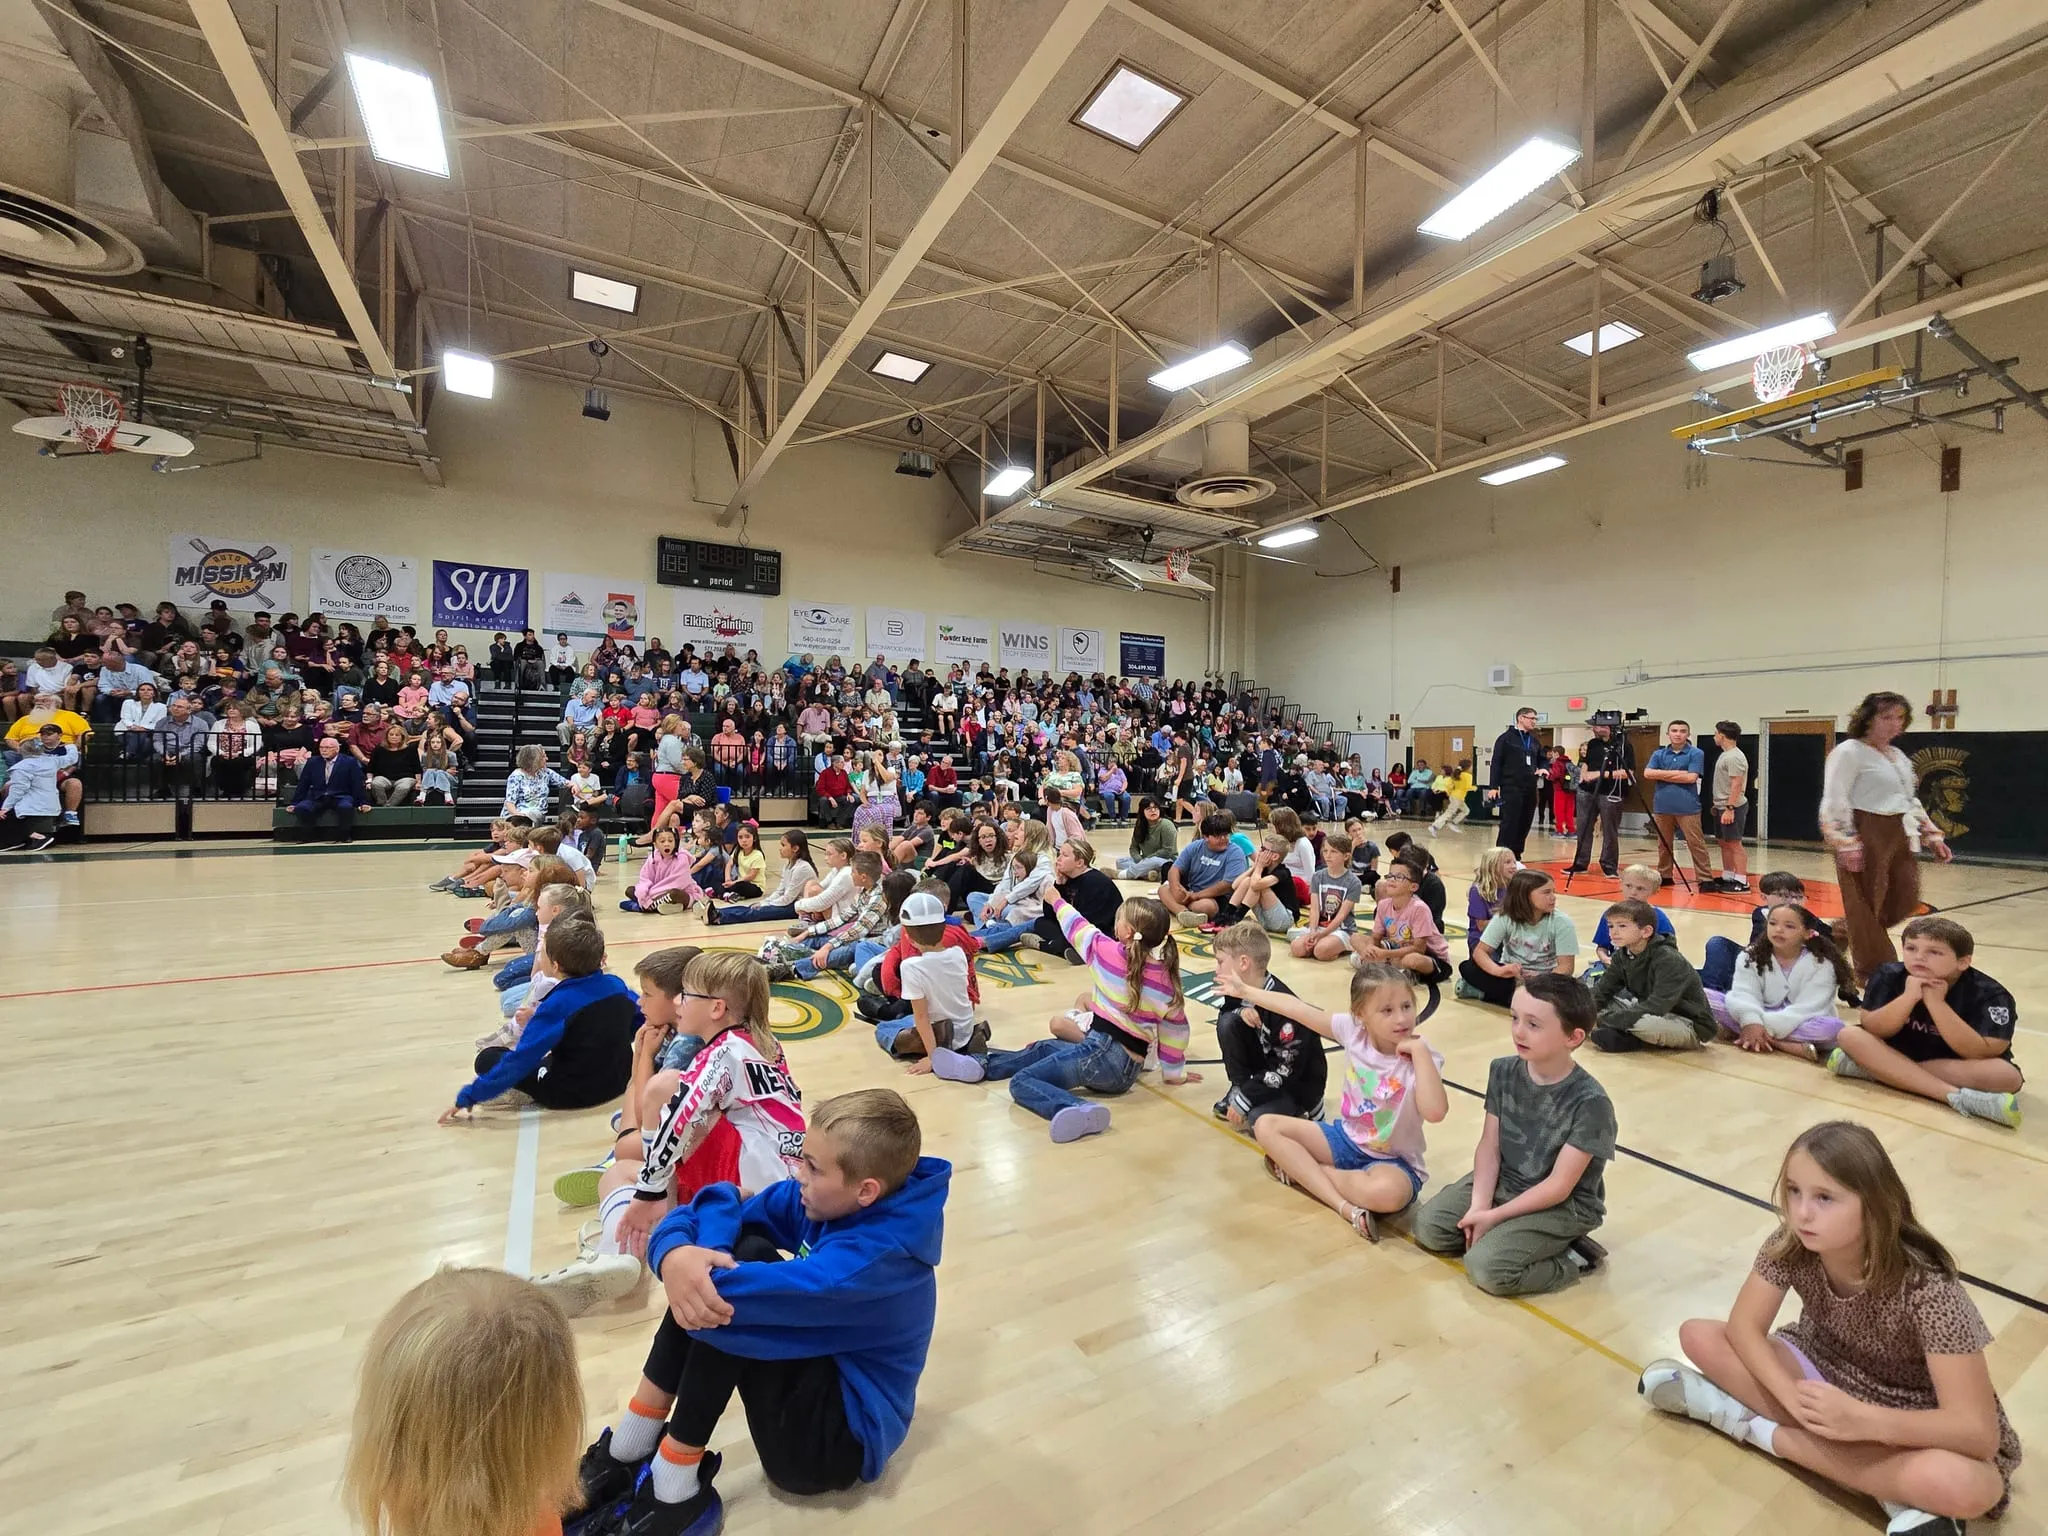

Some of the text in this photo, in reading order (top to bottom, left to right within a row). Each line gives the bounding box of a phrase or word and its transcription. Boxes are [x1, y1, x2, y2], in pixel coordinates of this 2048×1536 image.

[665, 541, 687, 552] Home
[212, 554, 242, 563] AUTO
[754, 553, 778, 564] Guests
[709, 577, 733, 587] period
[348, 590, 377, 599] MOTION
[319, 597, 410, 613] Pools and Patios
[437, 612, 525, 626] Spirit and Word
[793, 609, 810, 618] EYE
[683, 614, 754, 634] Elkins Painting
[830, 616, 851, 625] CARE
[1002, 632, 1049, 651] WINS
